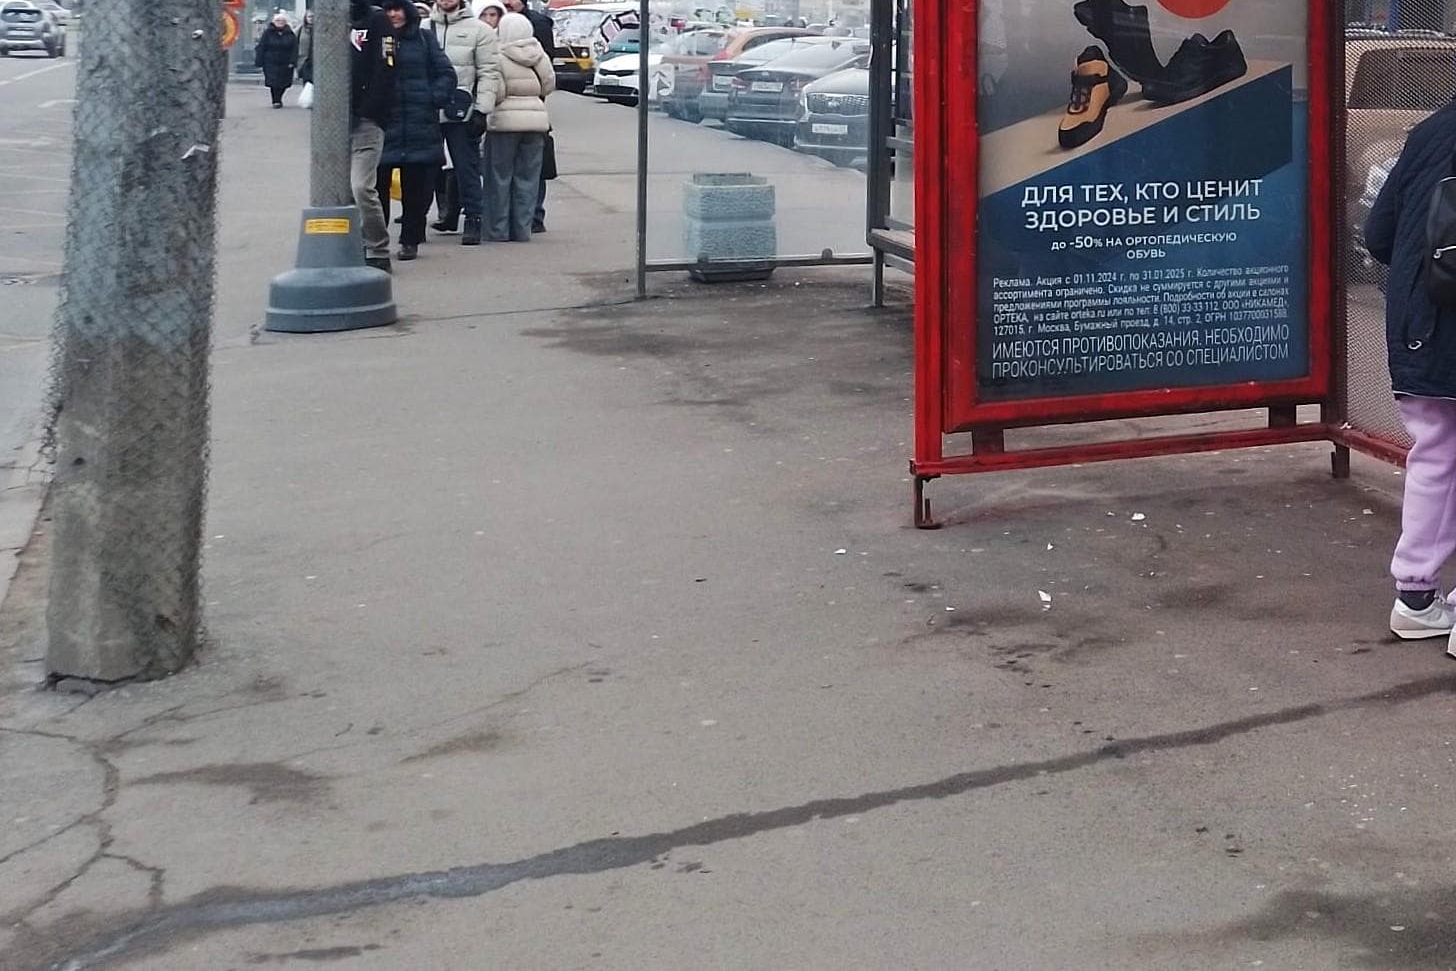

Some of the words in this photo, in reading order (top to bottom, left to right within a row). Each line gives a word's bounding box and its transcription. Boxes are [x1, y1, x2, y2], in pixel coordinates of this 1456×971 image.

[1022, 185, 1073, 208] ДЛЯ
[1081, 183, 1129, 204] ТЕХ,
[1135, 182, 1180, 201] КТО
[1187, 179, 1264, 201] ЦЕНИТ
[1025, 207, 1156, 232] ЗДОРОВЬЕ
[1163, 206, 1179, 223] И
[1185, 203, 1261, 222] СТИЛЬ
[1051, 241, 1067, 251] до
[1069, 236, 1103, 248] -50%
[1106, 236, 1123, 246] НА
[1125, 232, 1237, 246] ОРТОПЕДИЧЕСКУЮ
[1126, 249, 1166, 260] ОБУВЬ
[1035, 275, 1061, 287] Акция
[1073, 273, 1116, 283] 01.11.2024
[1129, 272, 1139, 280] по
[1142, 269, 1184, 279] 31.01.2025
[1196, 266, 1242, 277] Количество
[1245, 266, 1288, 274] акционного
[993, 290, 1052, 302] ассортимента
[1055, 287, 1104, 298] ограничено.
[1108, 284, 1137, 293] Скидка
[1153, 282, 1203, 293] суммируется
[1213, 279, 1245, 289] другими
[1248, 278, 1280, 286] акциями
[993, 301, 1062, 312] предложениями
[1063, 298, 1111, 309] программы
[1163, 290, 1214, 302] Подробности
[1216, 289, 1225, 298] об
[1258, 288, 1288, 296] салонах
[1033, 313, 1043, 321] на
[1045, 310, 1069, 320] сайте
[1070, 308, 1105, 319] orteka.ru
[1107, 308, 1121, 316] или
[1160, 303, 1179, 315] (800)
[1222, 300, 1239, 309] ООО
[1074, 319, 1117, 333] Бумажный
[1204, 313, 1226, 322] ОГРН
[992, 339, 1059, 359] ИМЕЮТСЯ
[1062, 329, 1201, 356] ПРОТИВОПОКАЗАНИЯ.
[1205, 324, 1288, 347] НЕОБХОДИМО
[992, 349, 1162, 381] ПРОКОНСУЛЬТИРОВАТЬСЯ
[1165, 351, 1183, 366] СО
[1186, 342, 1287, 365] СПЕЦИАЛИСТОМ
